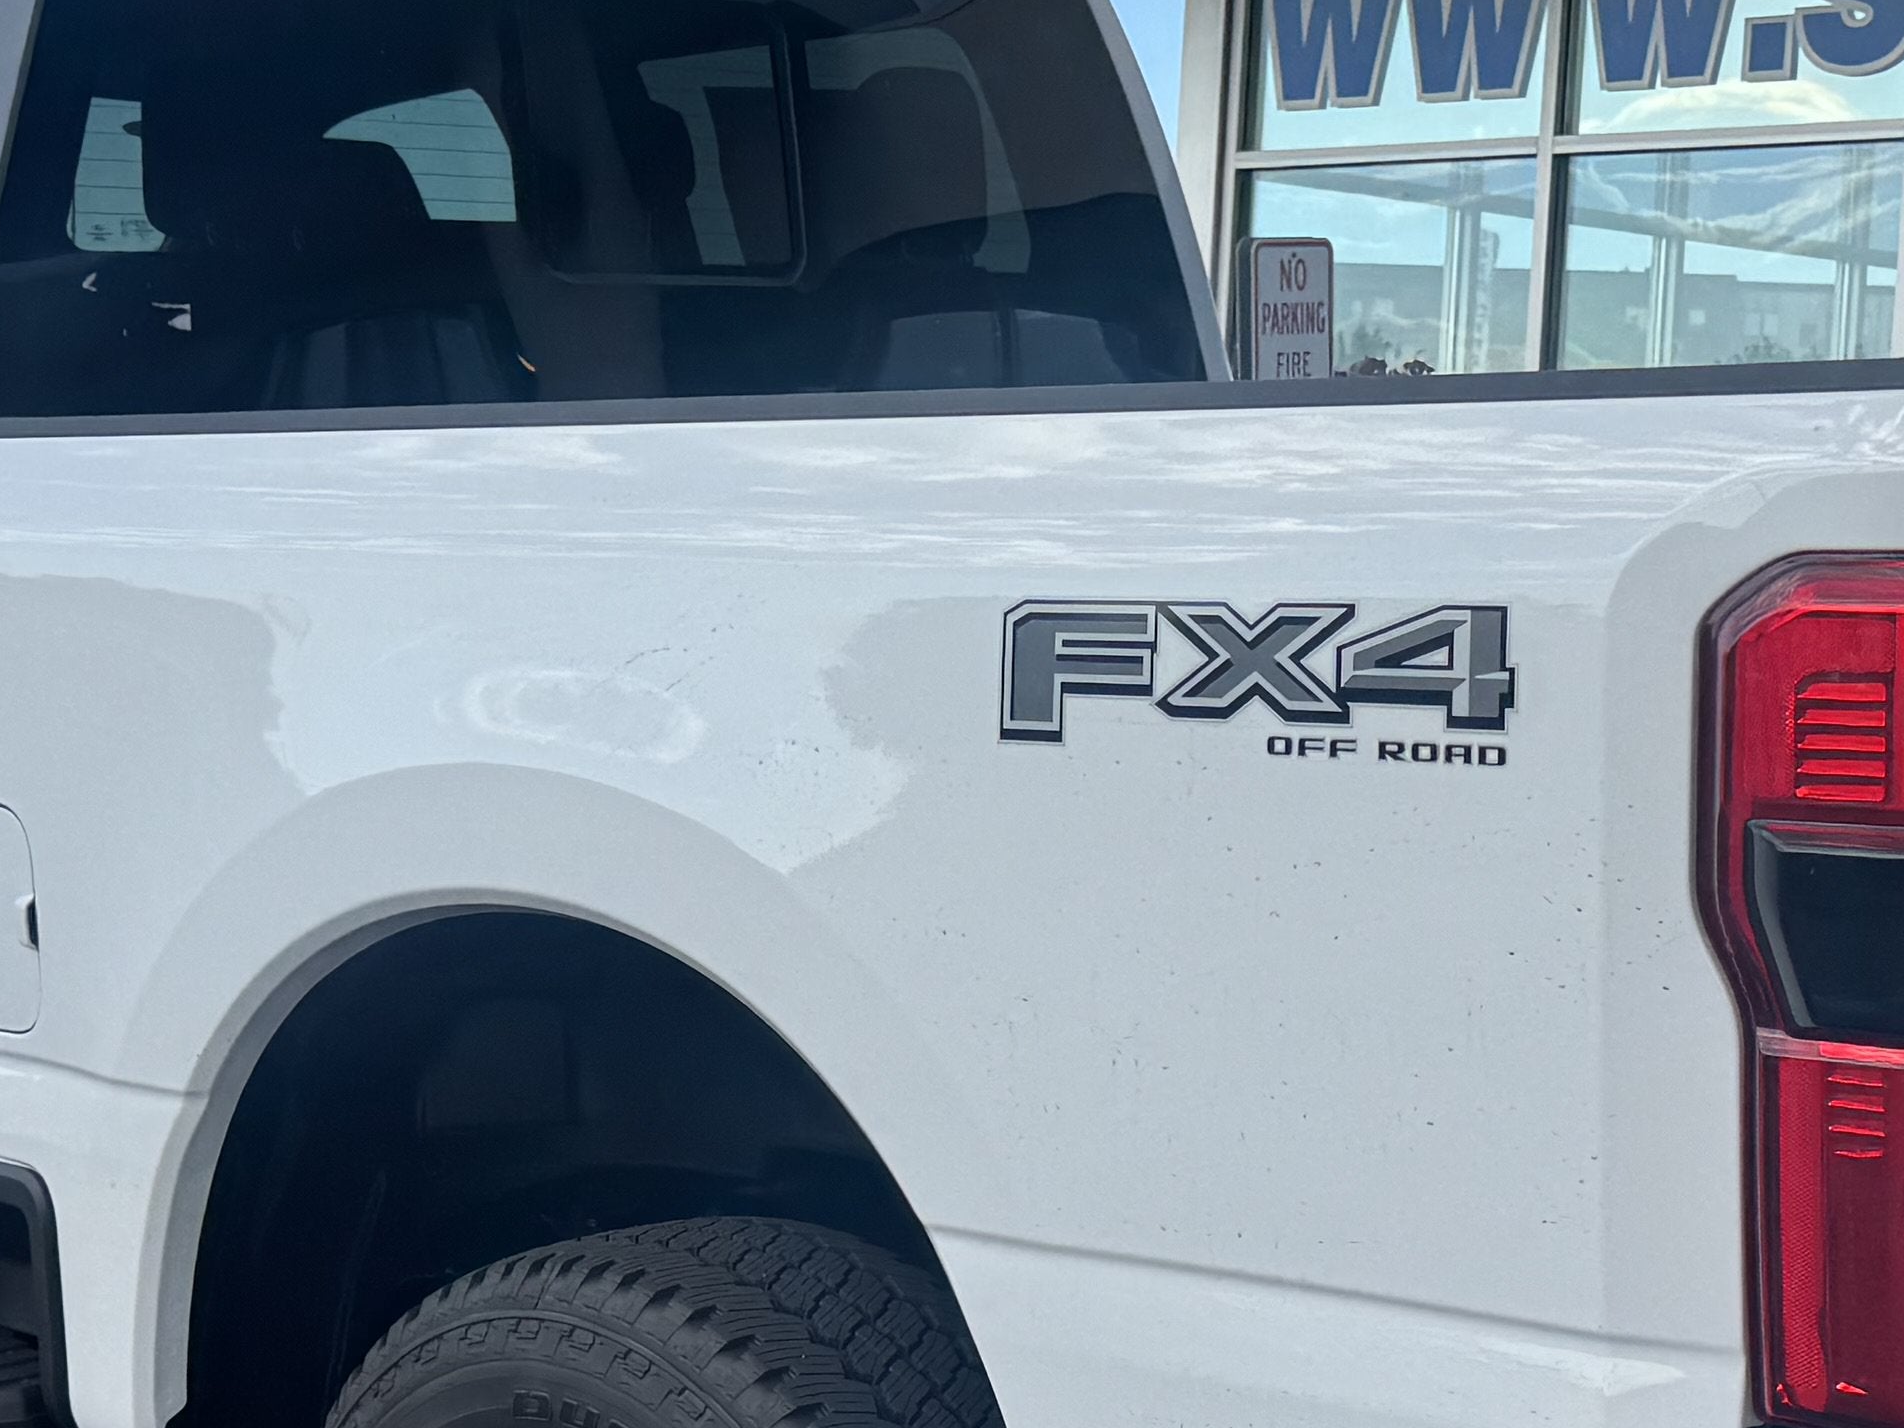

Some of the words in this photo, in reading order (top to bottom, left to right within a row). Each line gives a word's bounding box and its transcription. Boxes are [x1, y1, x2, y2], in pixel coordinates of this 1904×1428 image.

[1279, 257, 1307, 292] NO
[1262, 301, 1326, 336] PARKING
[1276, 351, 1312, 377] FIRE
[998, 599, 1518, 745] FX4
[1267, 736, 1358, 759] OFF
[1377, 740, 1507, 768] ROAD
